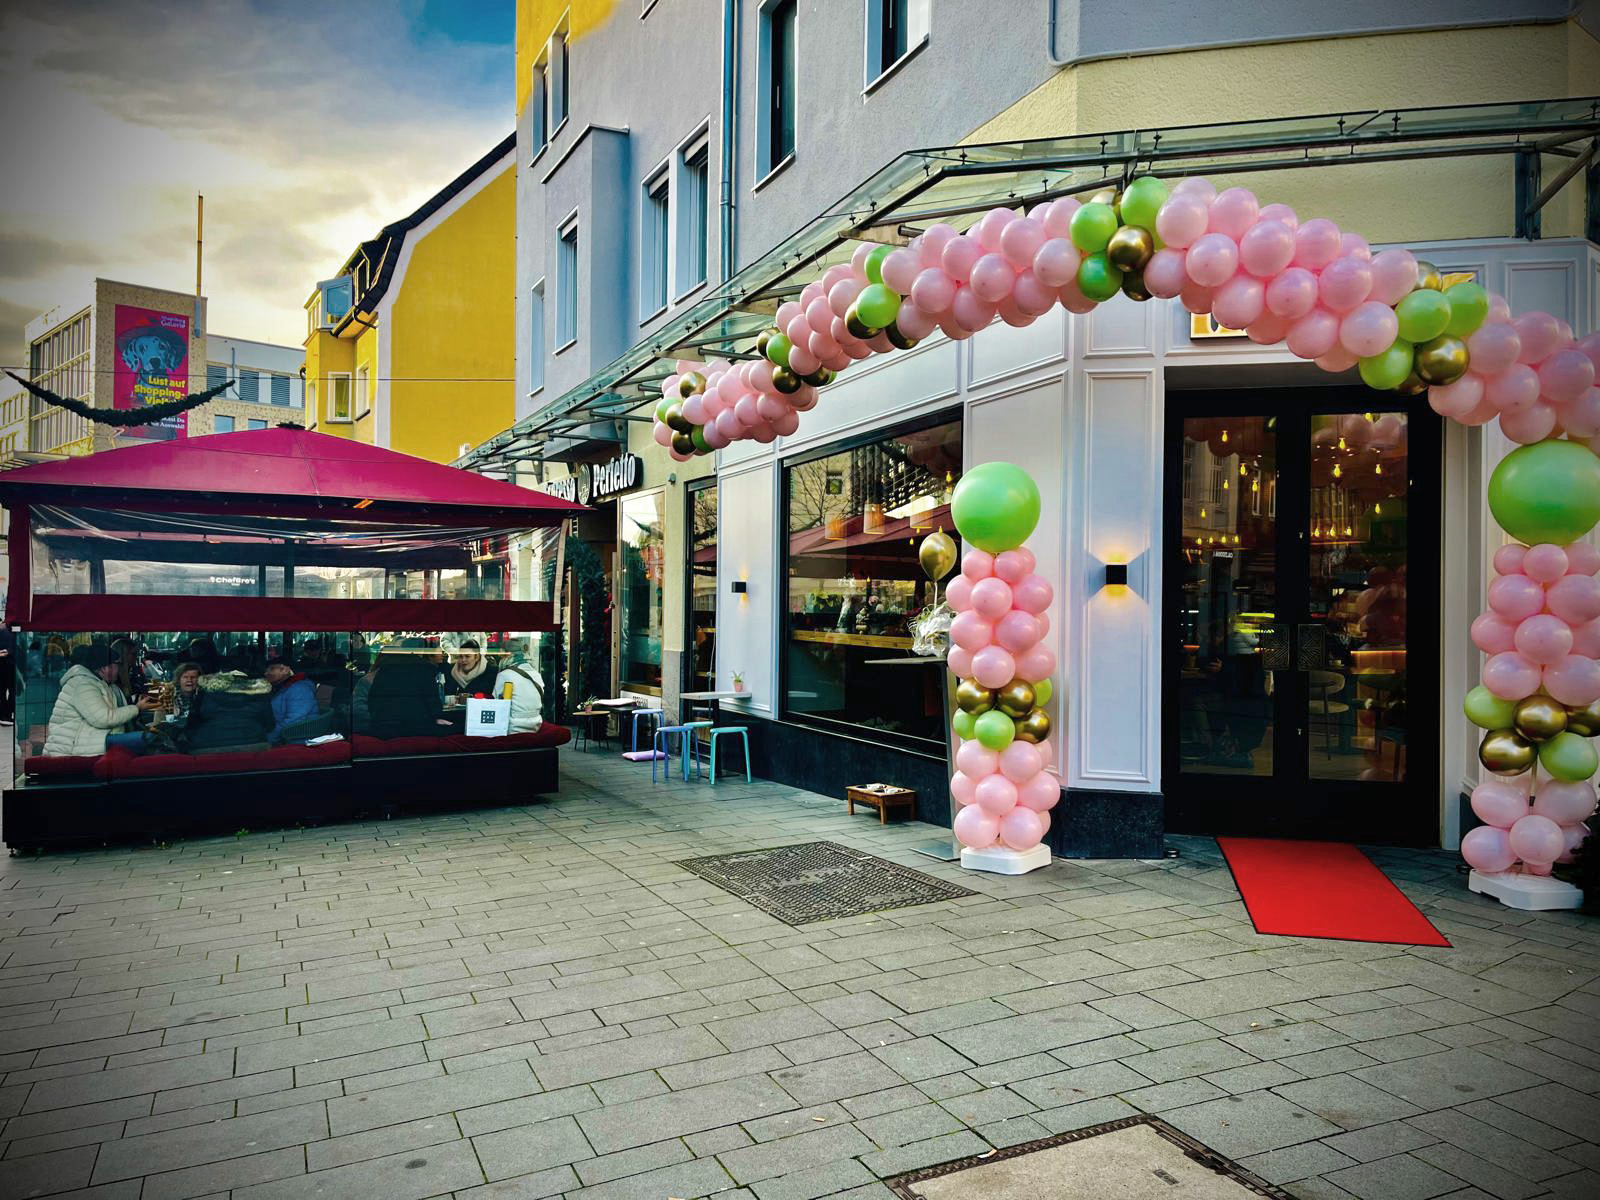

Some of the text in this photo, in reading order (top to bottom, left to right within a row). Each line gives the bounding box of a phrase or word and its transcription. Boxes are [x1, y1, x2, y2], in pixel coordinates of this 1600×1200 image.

[148, 375, 186, 388] Lust auf
[592, 452, 636, 498] Perfetto
